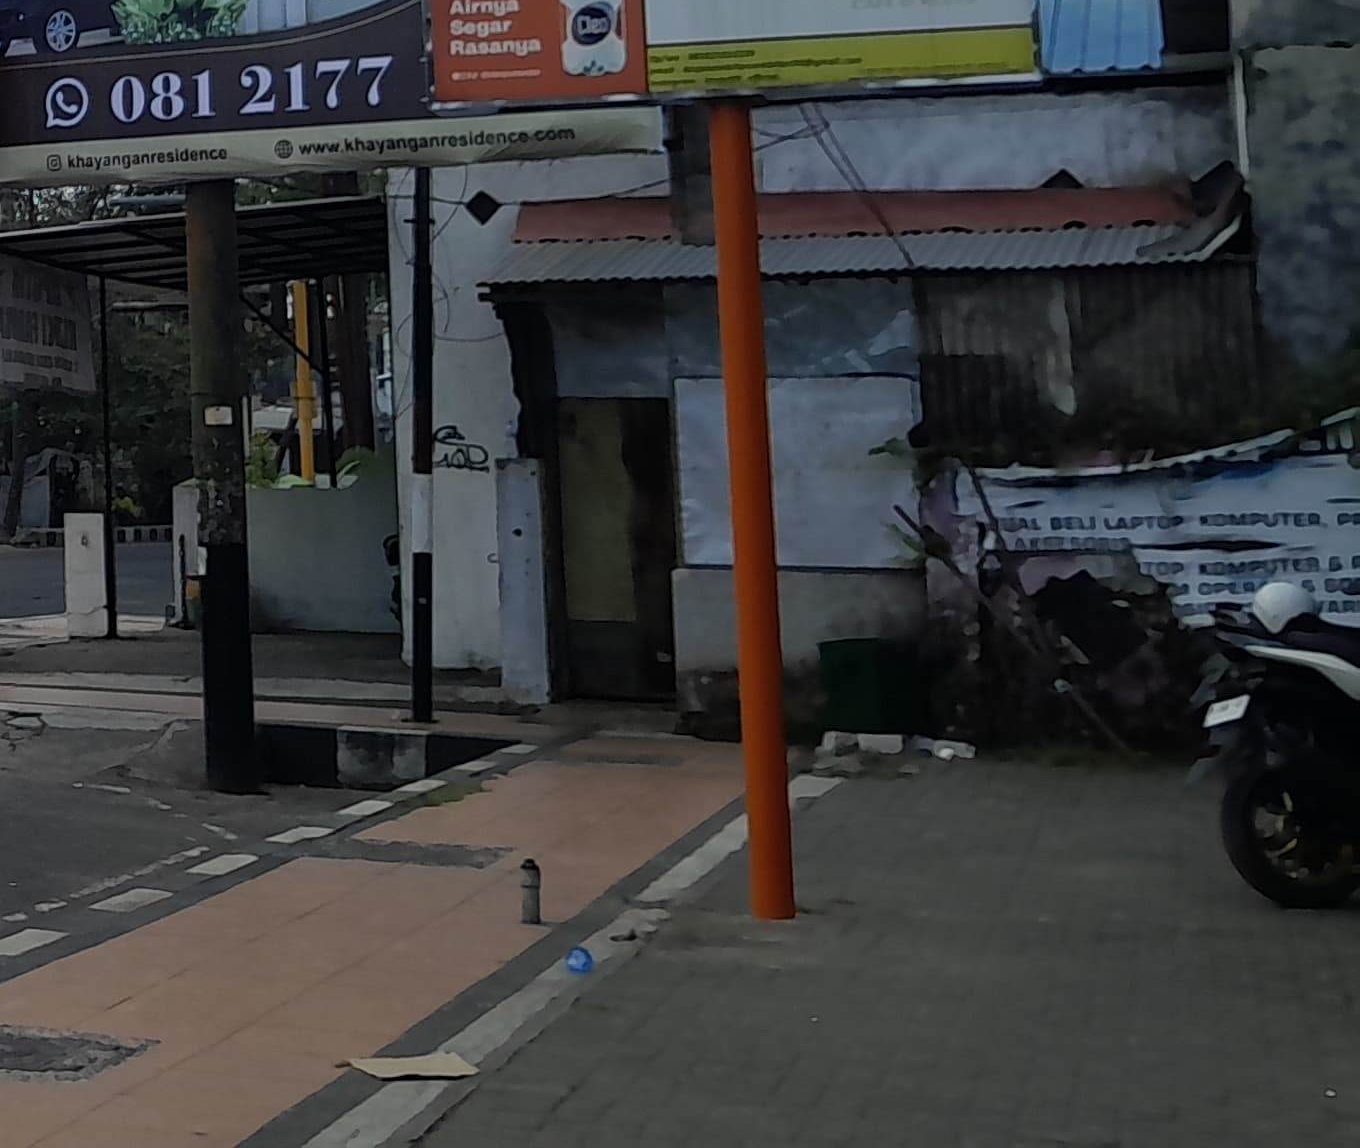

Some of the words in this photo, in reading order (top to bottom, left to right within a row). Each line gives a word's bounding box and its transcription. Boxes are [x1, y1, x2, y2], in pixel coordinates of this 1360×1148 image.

[449, 0, 520, 17] Airnya
[449, 18, 513, 38] Segar
[576, 14, 610, 35] Cleo
[449, 38, 542, 57] Rasanya
[109, 68, 217, 123] 081
[239, 55, 395, 116] 2177
[67, 146, 228, 171] khayanganresidence
[298, 126, 576, 157] www.khayanganresidence.com
